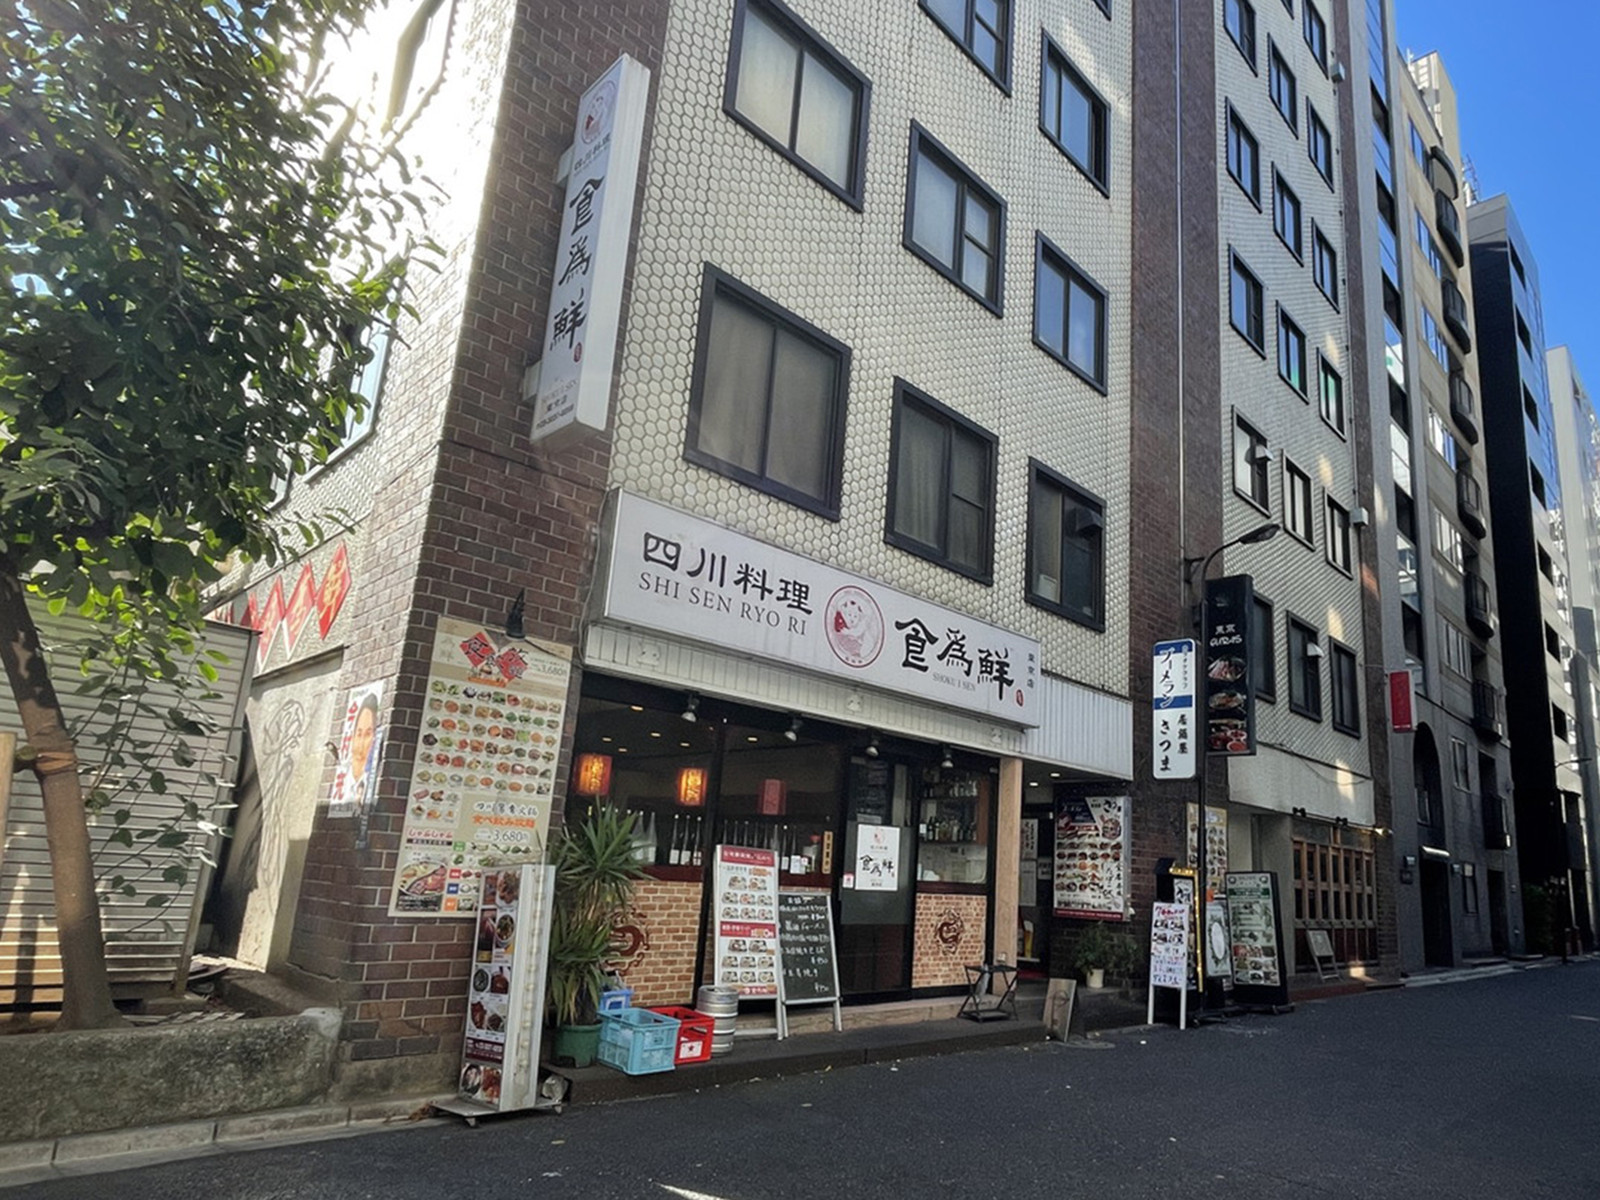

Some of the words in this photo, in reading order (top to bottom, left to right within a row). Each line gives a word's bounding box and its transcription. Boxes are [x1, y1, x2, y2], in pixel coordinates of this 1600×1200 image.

[638, 571, 680, 600] SHI
[688, 586, 732, 613] SEN
[740, 602, 780, 627] RYO
[787, 616, 807, 635] RI
[643, 531, 812, 615] 四川料理
[1159, 647, 1175, 708] ブーメラン
[1159, 719, 1171, 772] さつま
[1177, 713, 1188, 754] 居酒屋
